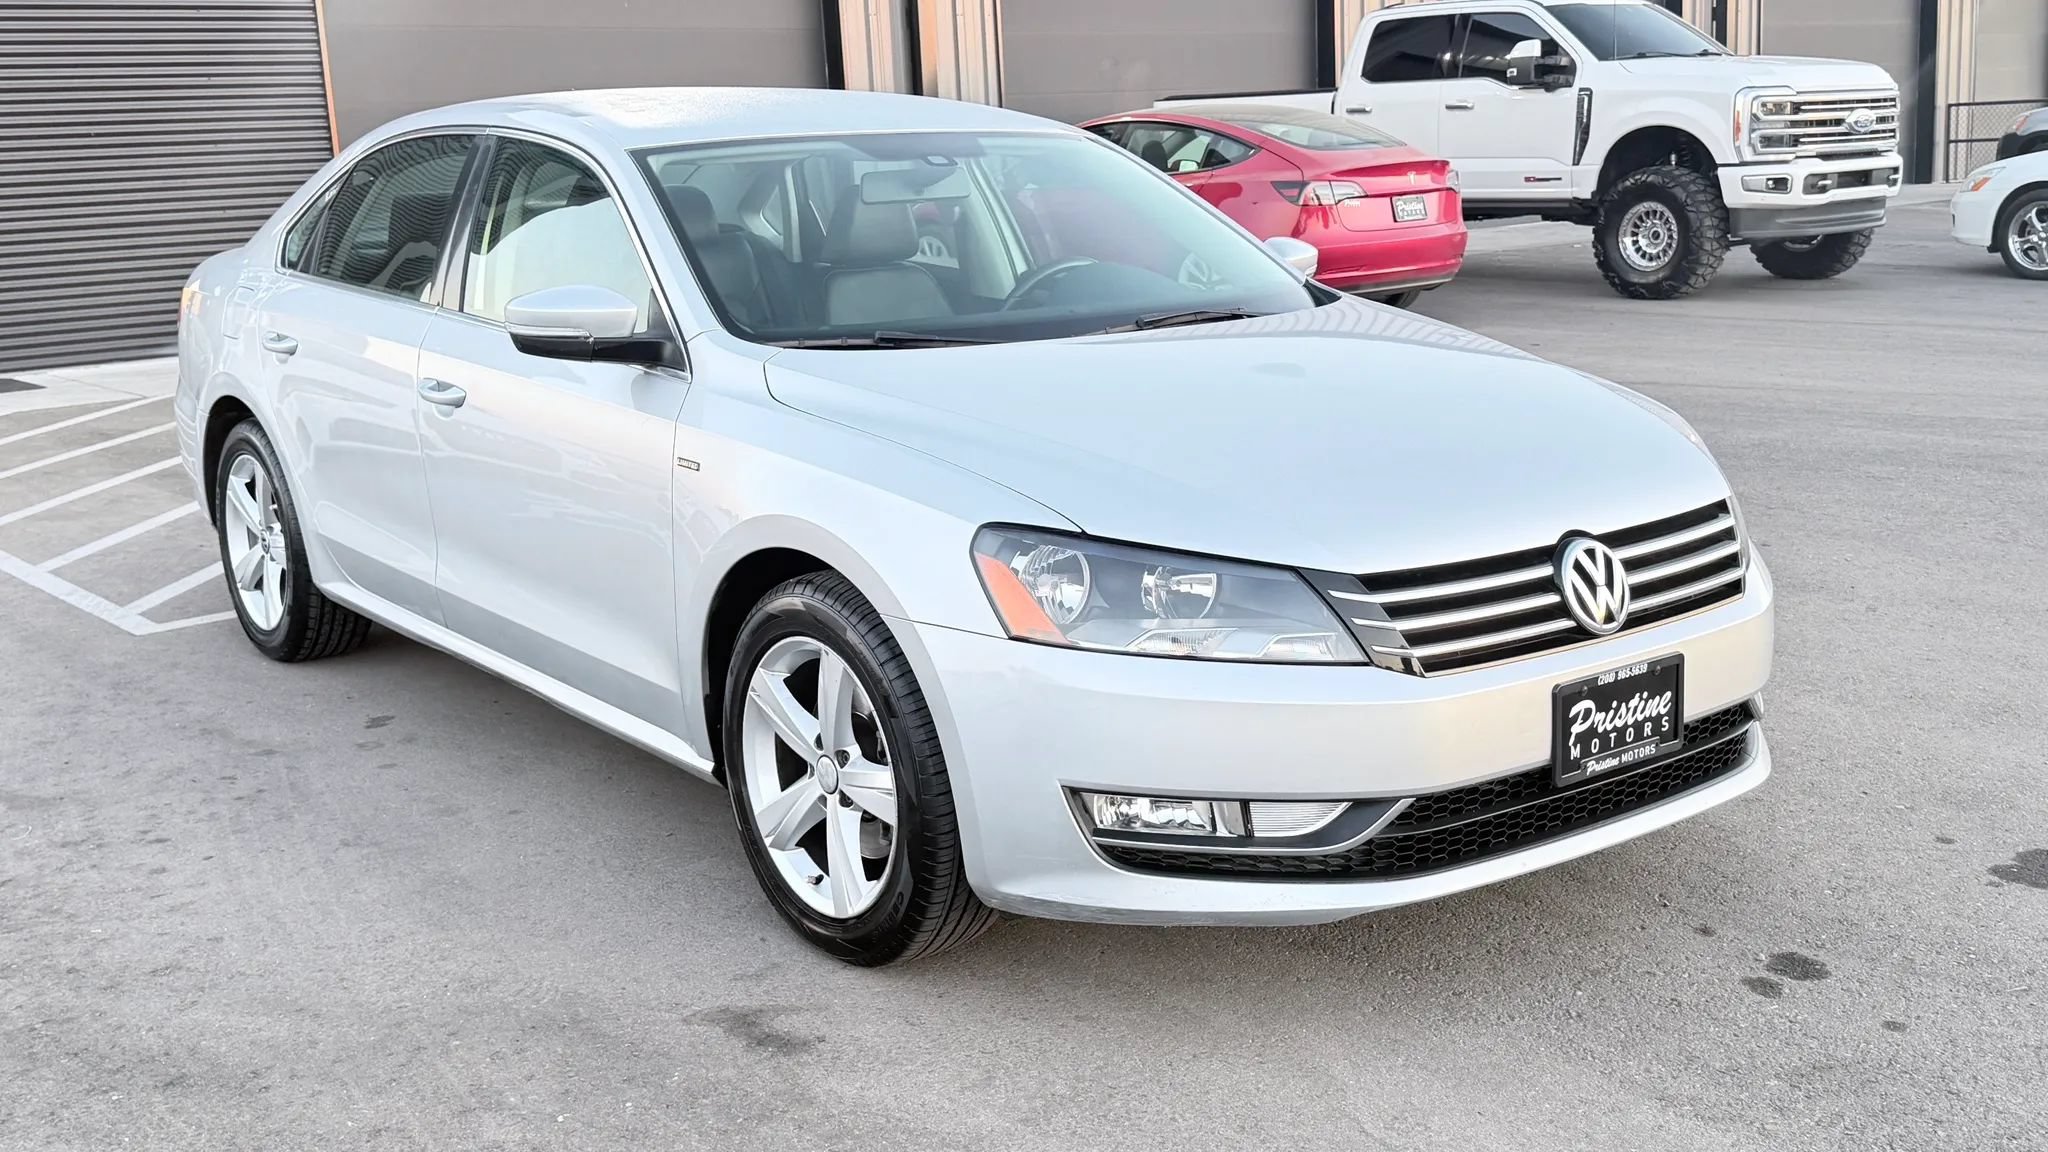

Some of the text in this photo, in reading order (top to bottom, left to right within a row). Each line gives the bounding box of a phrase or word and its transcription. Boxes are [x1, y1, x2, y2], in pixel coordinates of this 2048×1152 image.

[1597, 672, 1616, 686] (208)
[1568, 690, 1672, 746] Pristine
[1570, 716, 1670, 760] MOTORS
[1586, 744, 1656, 776] Pristine MOTORS
